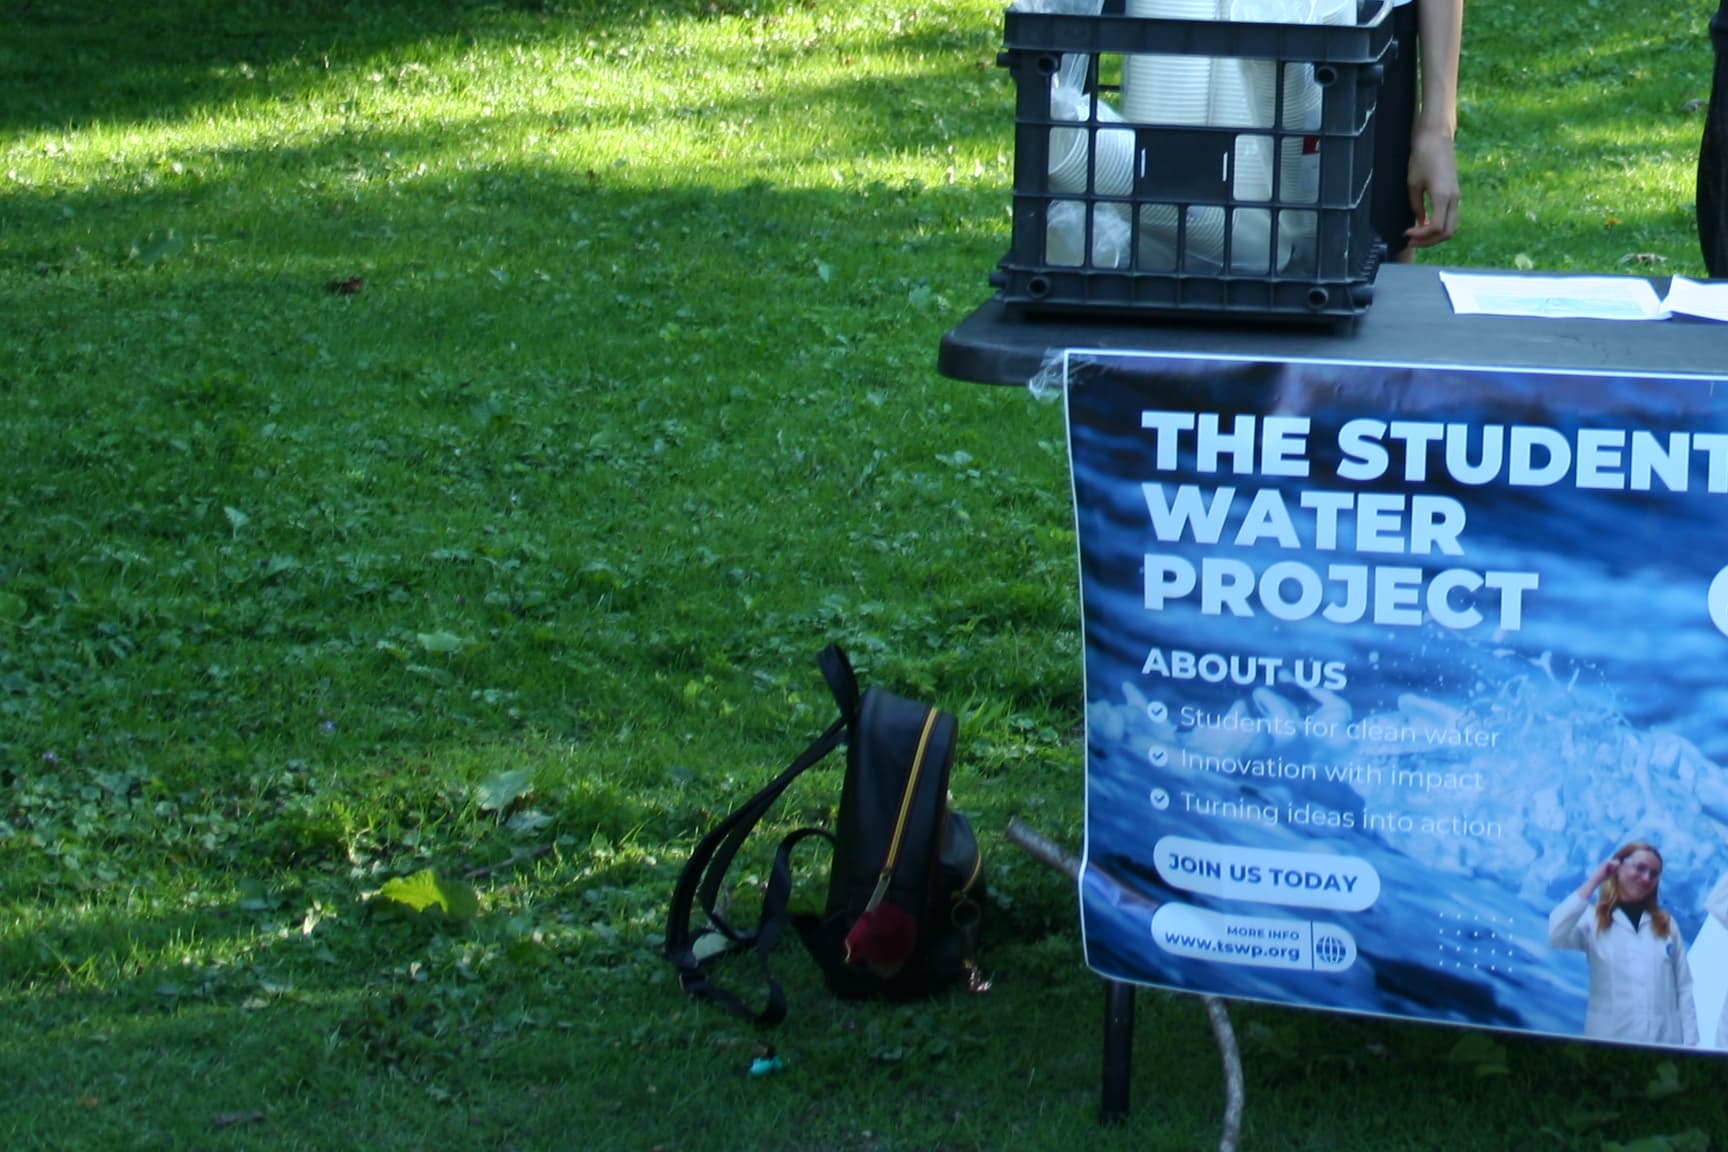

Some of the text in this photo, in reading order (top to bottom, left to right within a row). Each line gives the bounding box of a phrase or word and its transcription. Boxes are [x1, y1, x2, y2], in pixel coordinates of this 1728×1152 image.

[1141, 410, 1311, 477] THE
[1141, 482, 1467, 556] WATER
[1143, 553, 1540, 632] PROJECT
[1141, 647, 1348, 691] ABOUT US
[1180, 705, 1501, 748] Students for clean water
[1180, 748, 1485, 793] Innovation with impact
[1180, 790, 1502, 838] Turning ideas into action
[1168, 853, 1358, 894] JOIN US TODAY
[1165, 932, 1301, 962] www.tswp.org
[1226, 924, 1300, 942] MORE INFO
